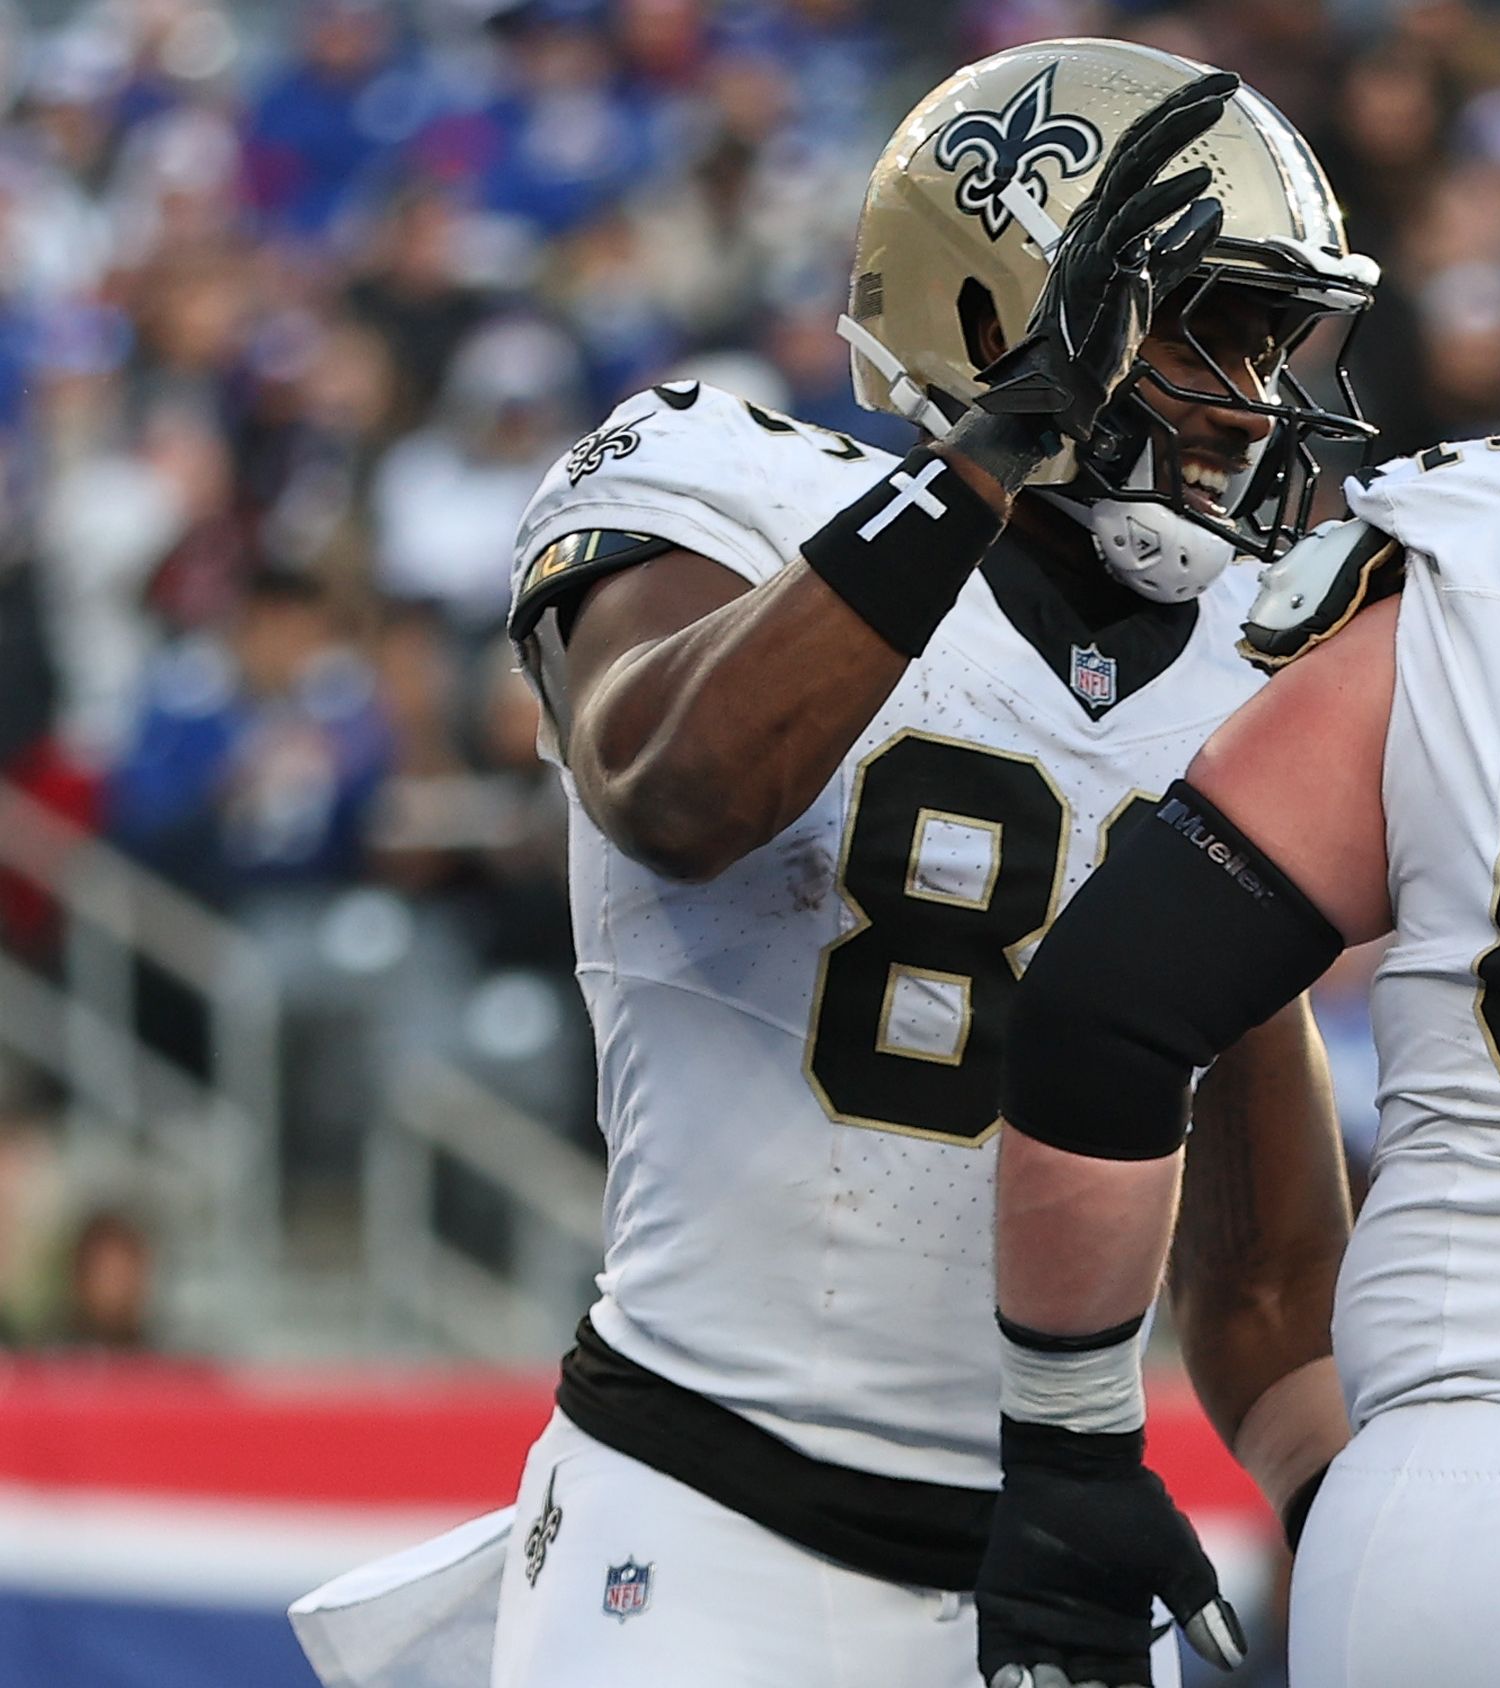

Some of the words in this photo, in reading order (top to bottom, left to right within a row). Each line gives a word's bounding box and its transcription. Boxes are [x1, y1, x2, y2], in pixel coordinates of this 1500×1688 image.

[1079, 669, 1108, 697] NFL
[803, 726, 1166, 1148] 8
[608, 1583, 642, 1609] NFL
